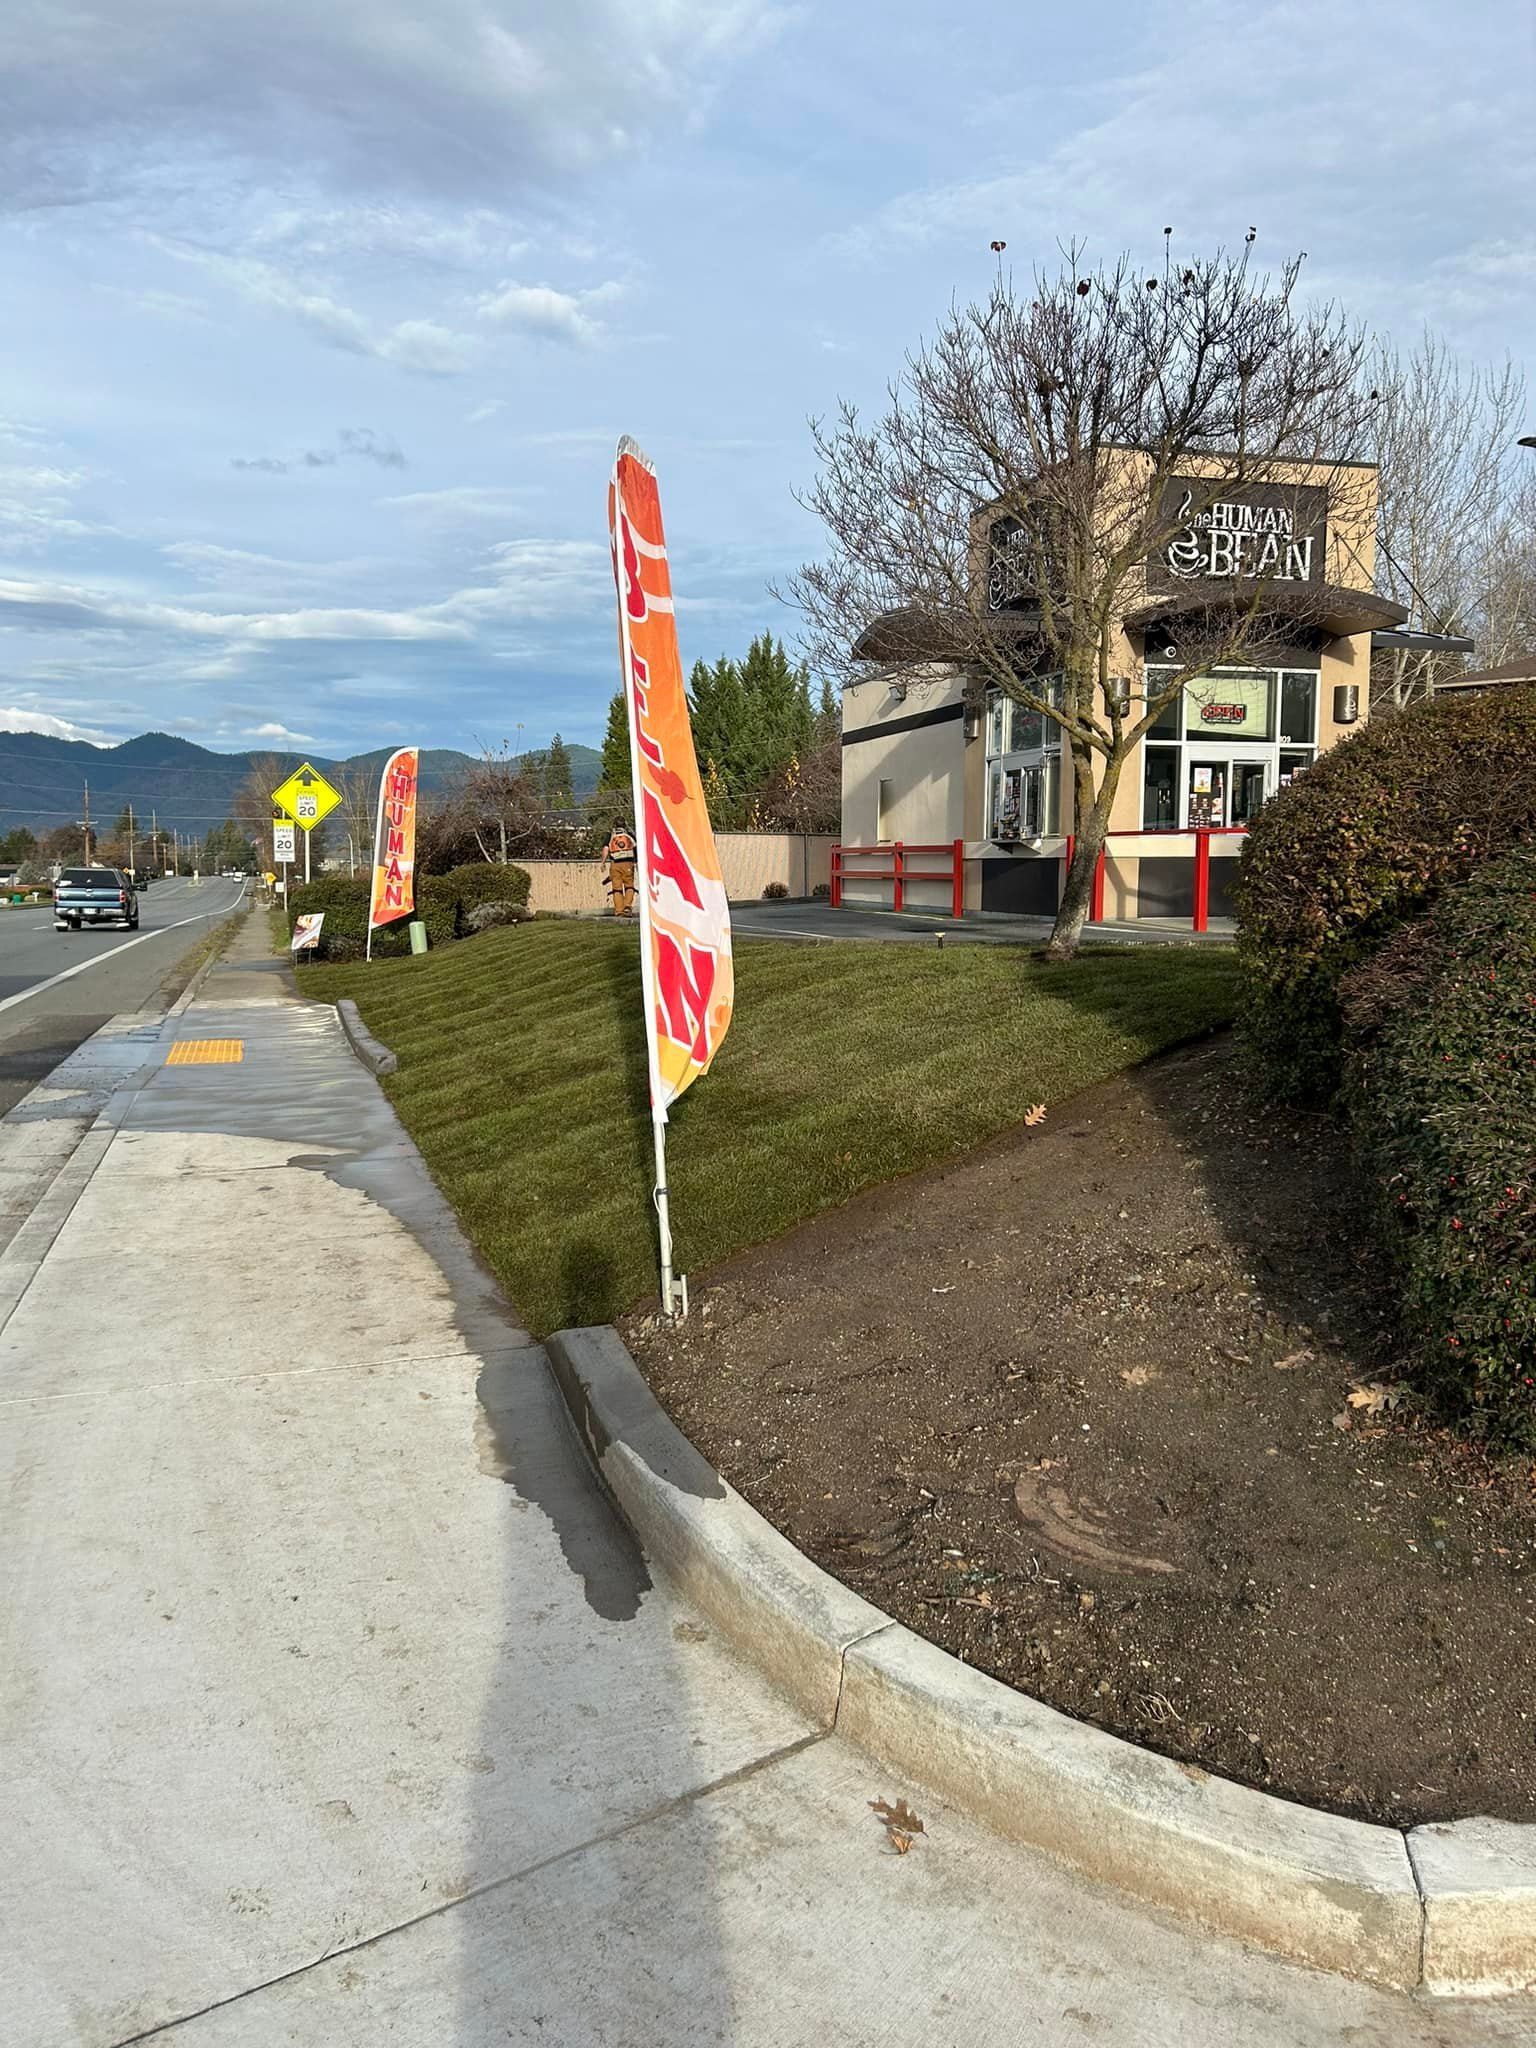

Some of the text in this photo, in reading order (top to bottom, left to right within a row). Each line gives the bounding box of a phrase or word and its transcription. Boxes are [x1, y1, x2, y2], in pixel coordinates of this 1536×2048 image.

[1212, 503, 1294, 534] HUMAN
[1205, 529, 1315, 581] BEAN
[1203, 705, 1244, 719] OPEN
[299, 806, 316, 816] 20
[277, 840, 292, 849] 20
[385, 775, 408, 907] HUMAN
